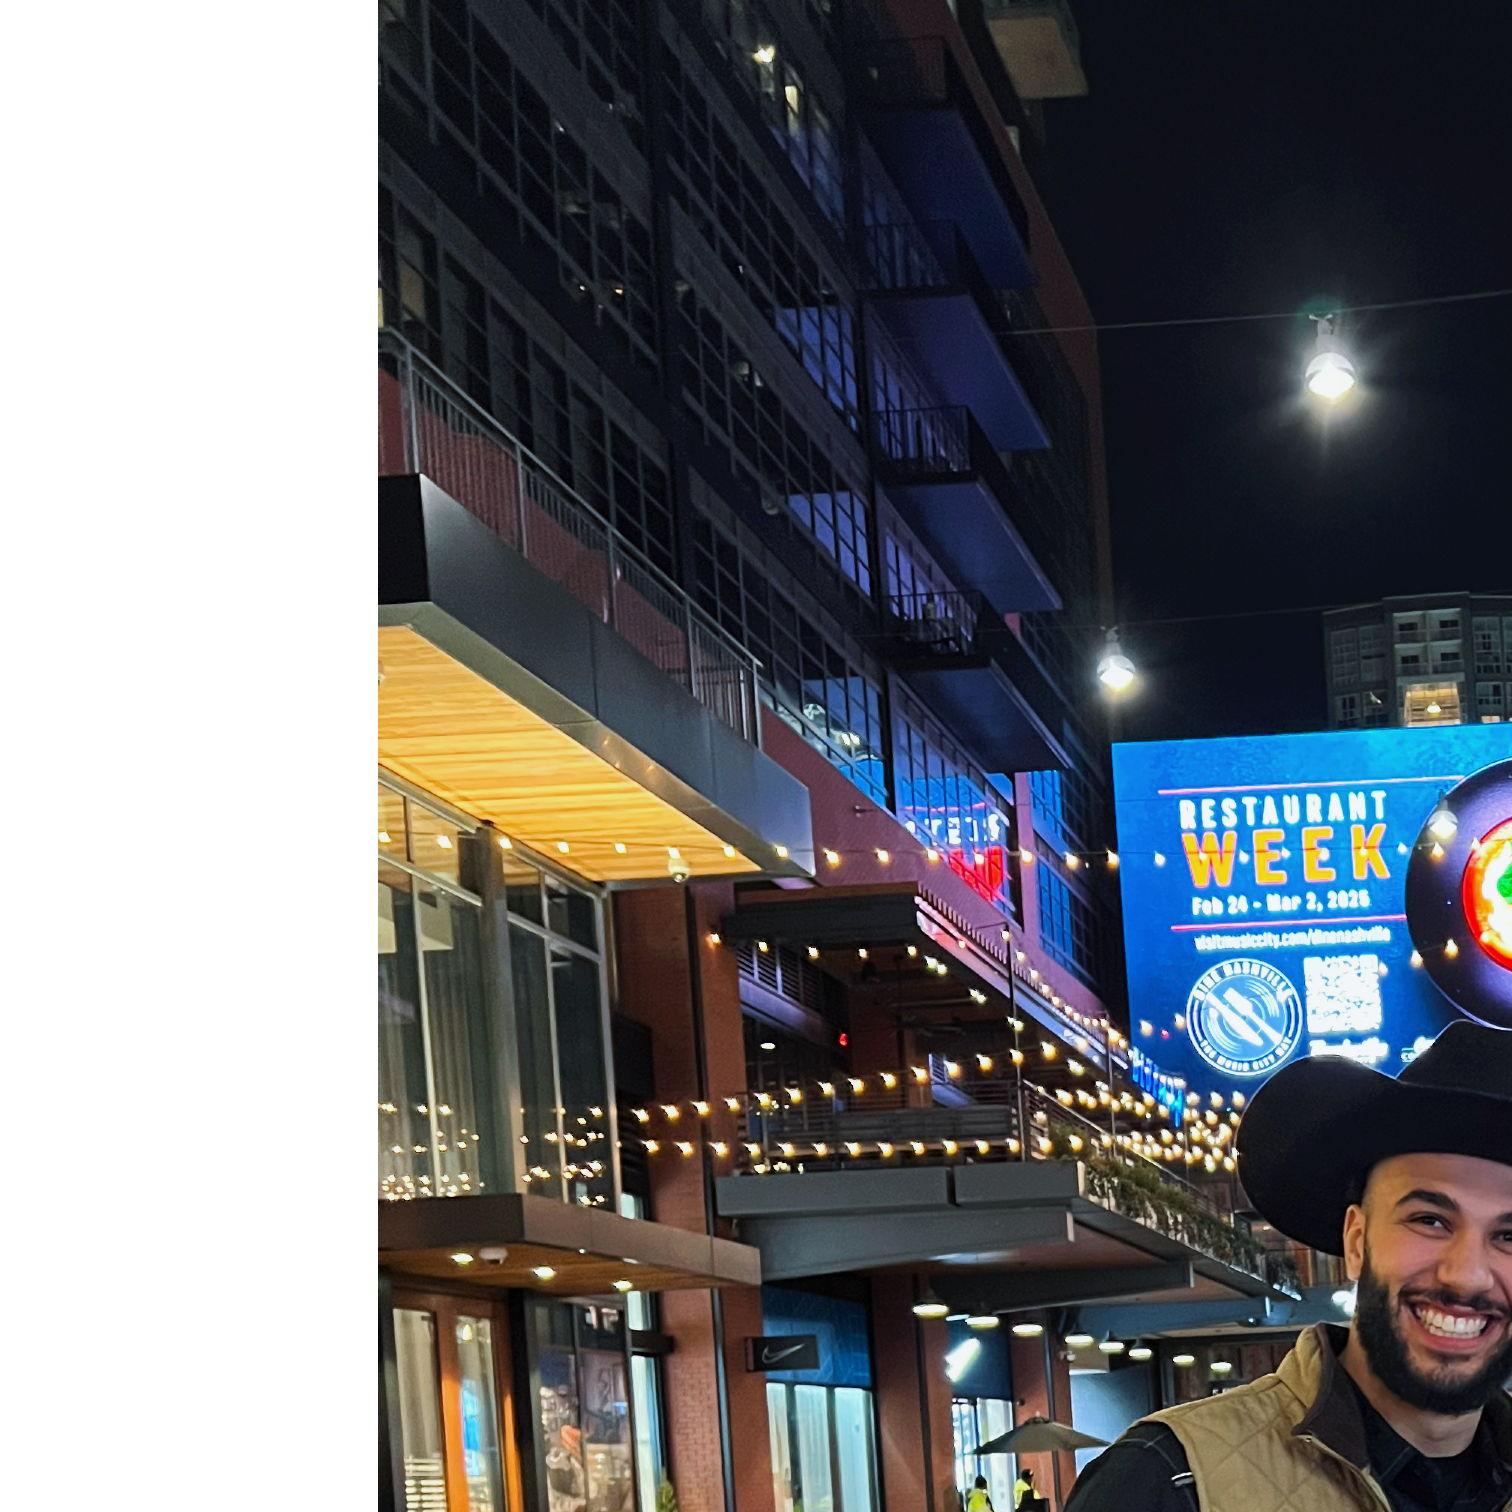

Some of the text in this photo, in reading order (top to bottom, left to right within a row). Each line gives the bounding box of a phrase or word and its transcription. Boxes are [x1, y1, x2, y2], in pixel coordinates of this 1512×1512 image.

[1179, 790, 1387, 830] RESTAURANT
[1181, 823, 1391, 888] WEEK
[1192, 896, 1223, 916] Feb
[1227, 894, 1249, 915] 24
[1266, 893, 1301, 912] Mar
[1305, 891, 1323, 912] 2,
[1327, 889, 1371, 909] 2025
[1193, 961, 1293, 1003] DINE NASHVILLE
